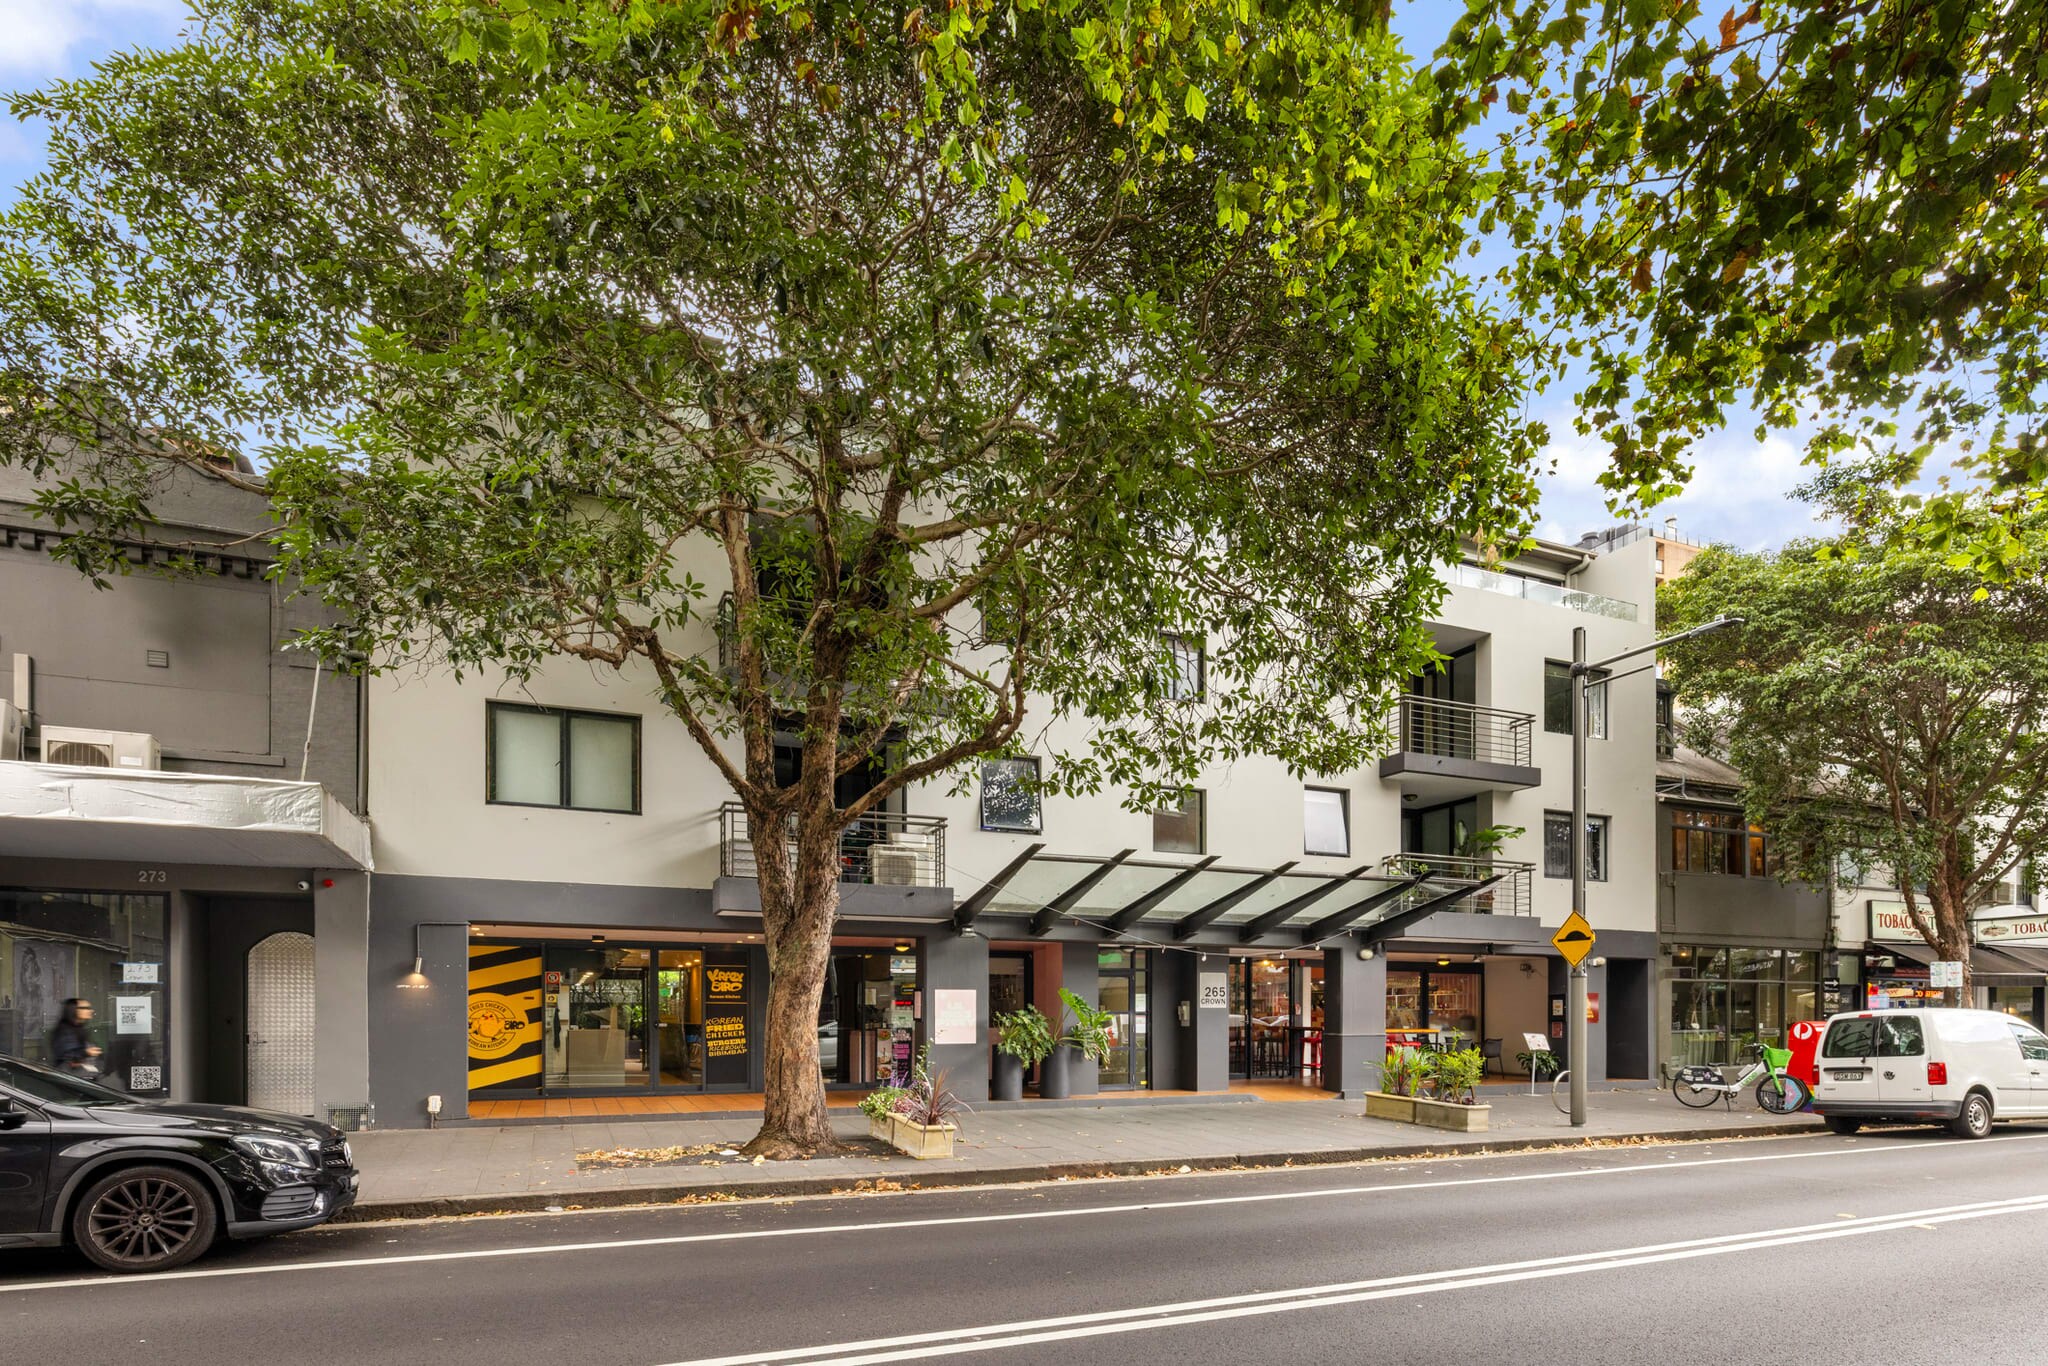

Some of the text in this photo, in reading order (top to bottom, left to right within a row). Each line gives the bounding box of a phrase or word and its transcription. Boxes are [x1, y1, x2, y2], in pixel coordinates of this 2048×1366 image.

[138, 870, 167, 882] 273
[711, 981, 743, 992] BIRD
[1204, 986, 1226, 997] 265
[469, 1002, 507, 1013] FRIED CHICKEN
[504, 1020, 525, 1030] BIRD
[705, 1016, 744, 1025] KOREAN
[705, 1023, 745, 1032] FRIED
[705, 1030, 745, 1039] CHICKEN
[487, 1038, 507, 1049] KITCHEN
[707, 1037, 747, 1047] BURGERS
[708, 1048, 748, 1057] BIBIMBAP
